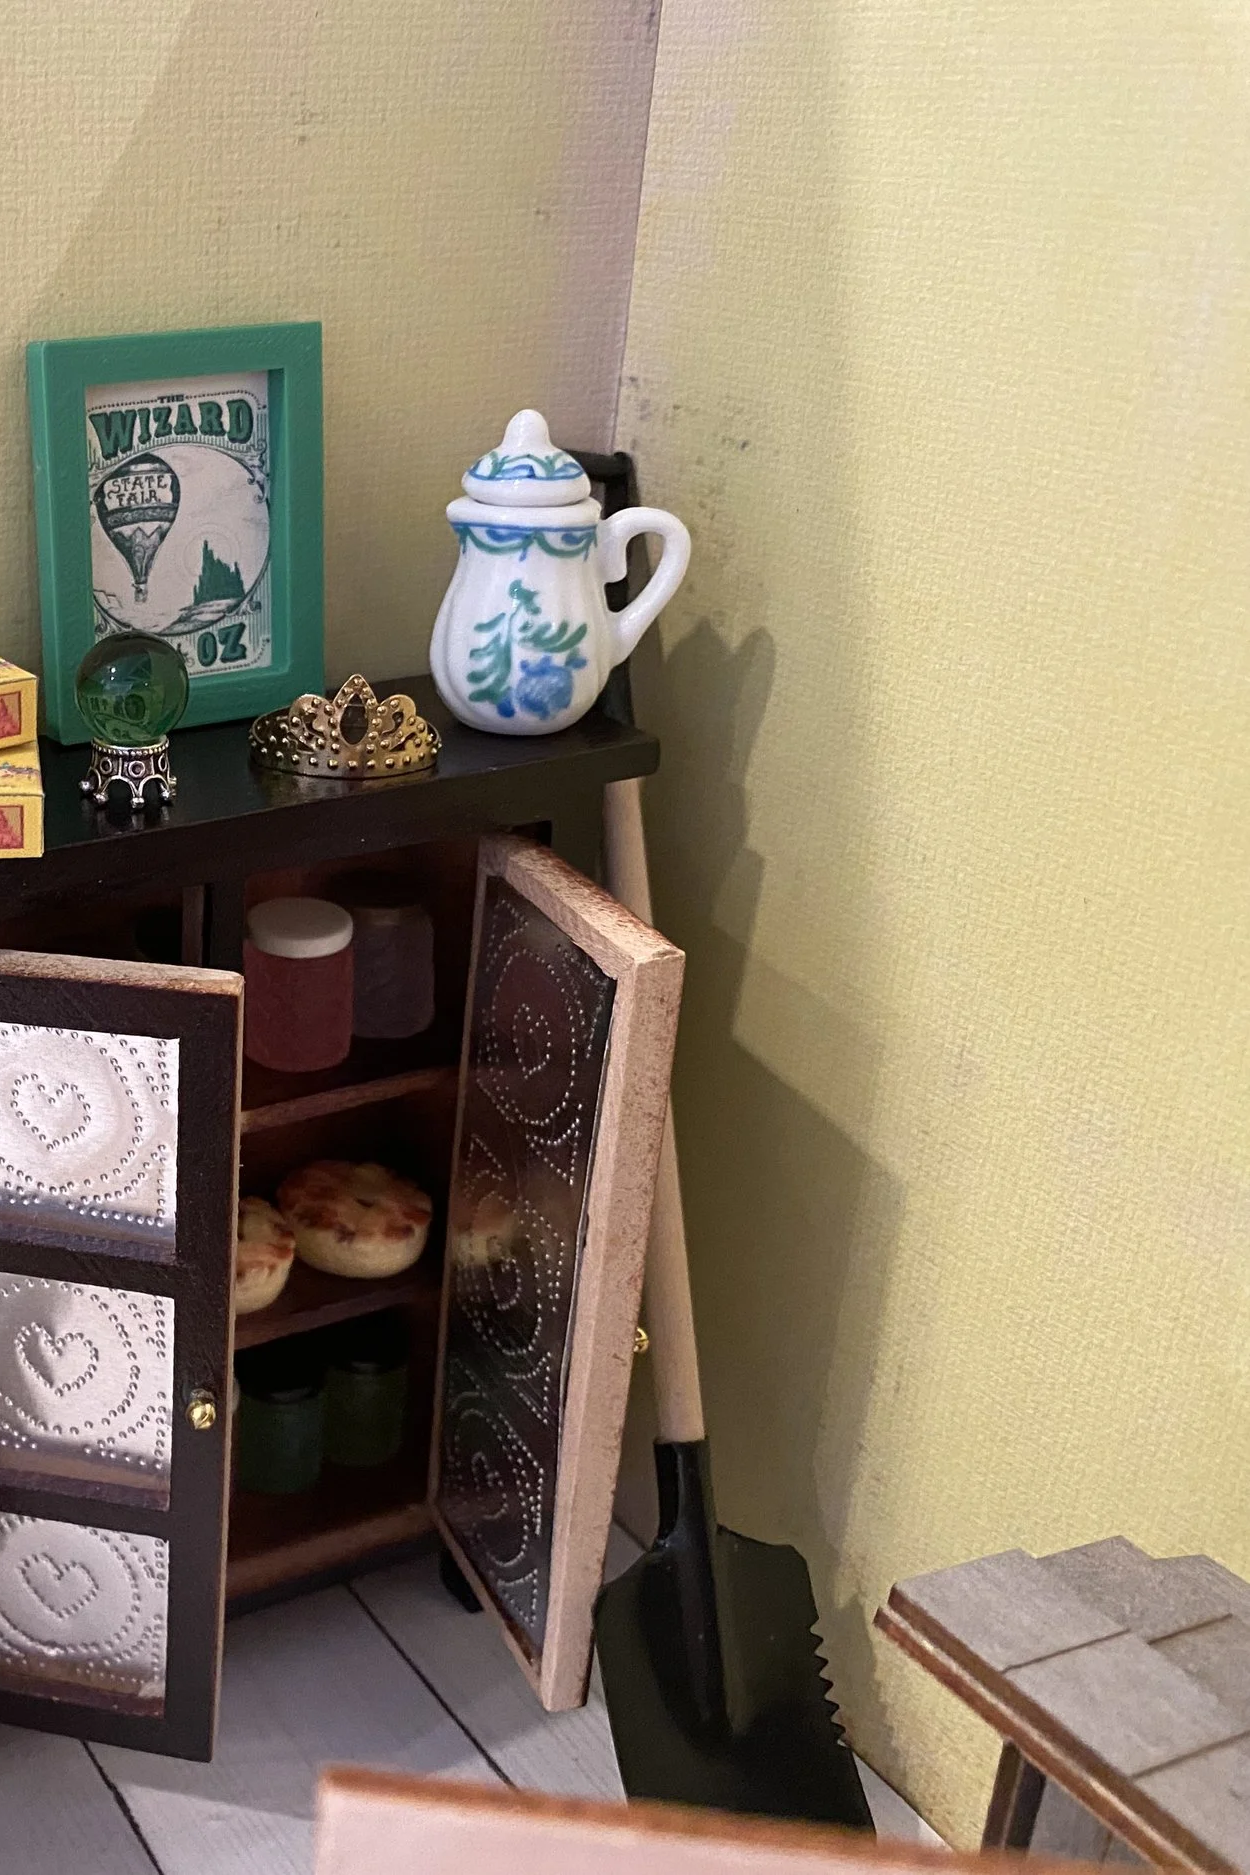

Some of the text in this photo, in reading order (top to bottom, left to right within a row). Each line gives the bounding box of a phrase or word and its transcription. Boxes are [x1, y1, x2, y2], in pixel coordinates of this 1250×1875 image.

[157, 394, 185, 404] THE
[89, 399, 254, 460] WIZARD
[108, 475, 167, 497] STATE
[197, 622, 247, 667] OZ
